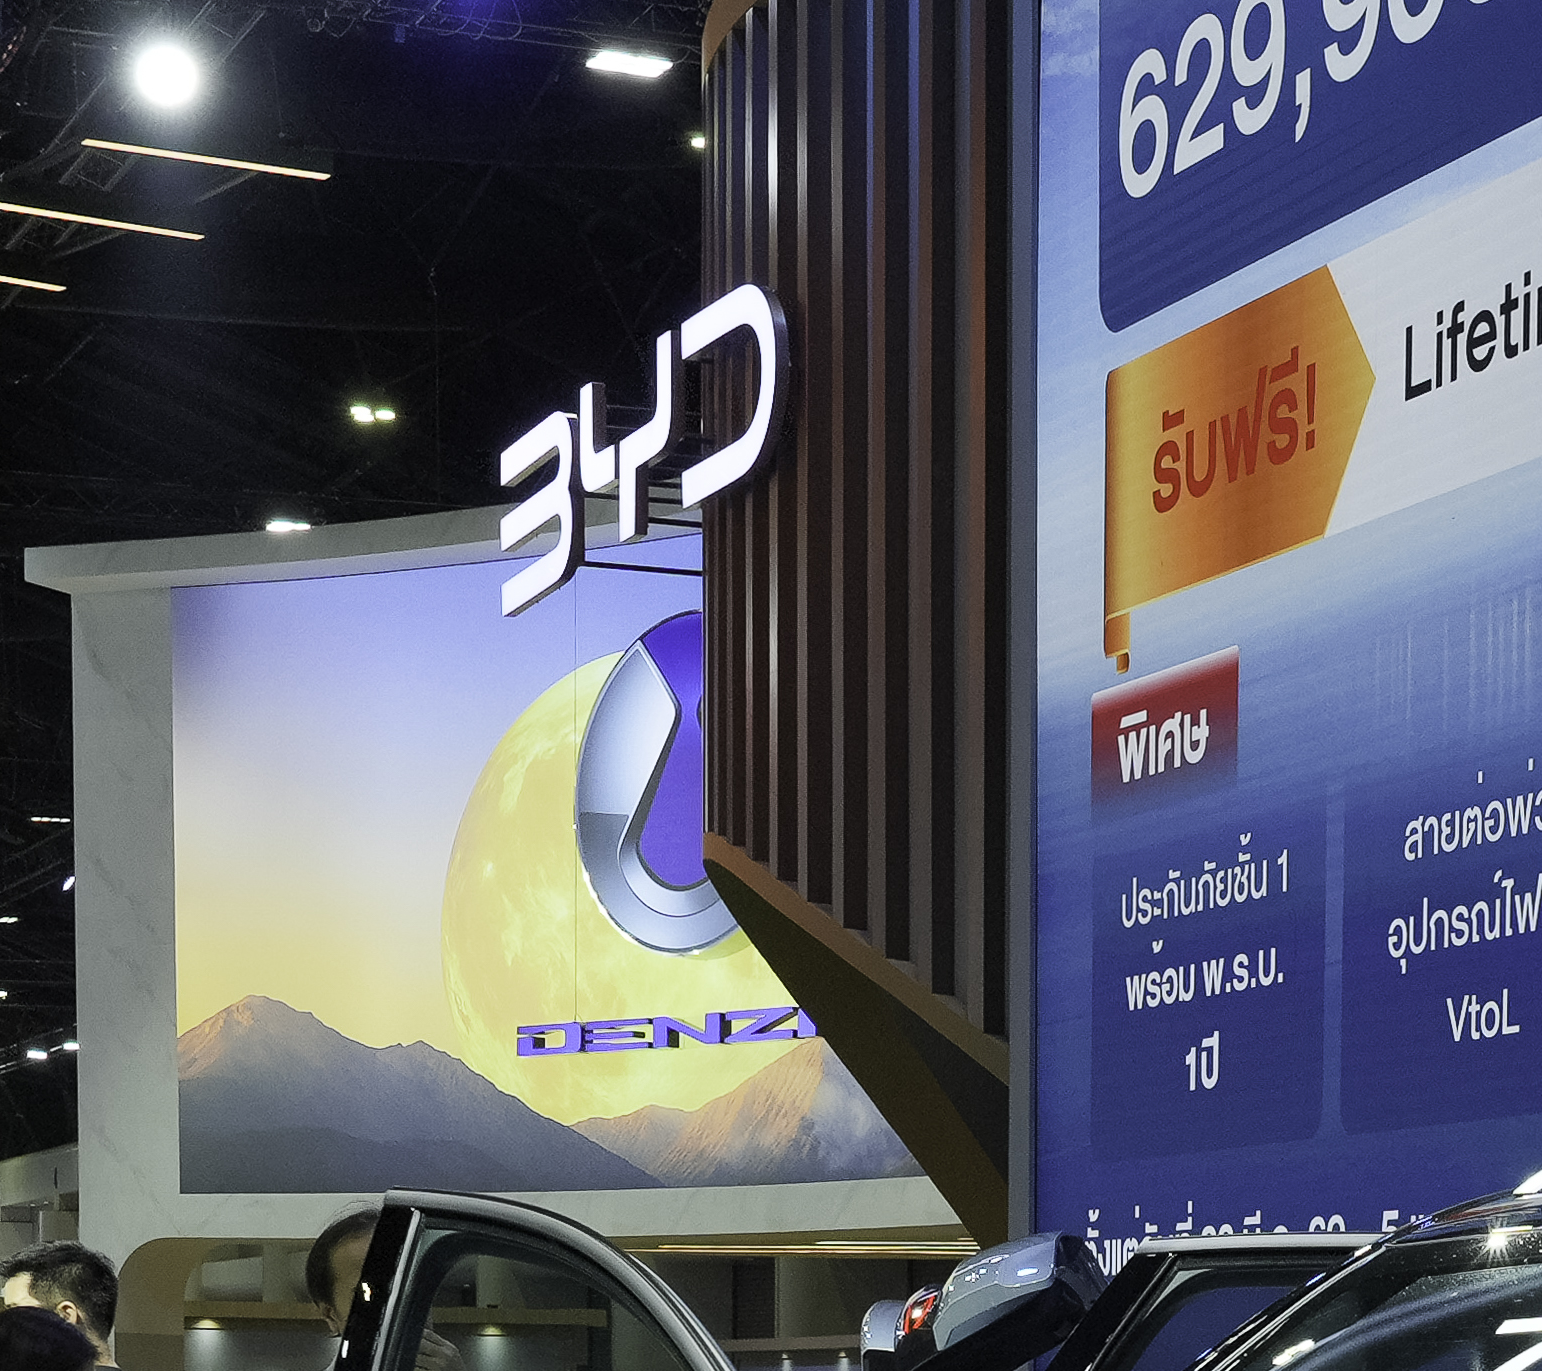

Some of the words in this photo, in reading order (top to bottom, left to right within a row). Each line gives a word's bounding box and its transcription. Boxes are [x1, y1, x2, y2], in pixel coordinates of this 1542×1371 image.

[1119, 0, 1490, 199] 629,9
[498, 283, 790, 618] BYD
[1152, 346, 1316, 517] รับฟรี!
[1118, 709, 1210, 783] พิเศษ
[1121, 833, 1268, 929] ประกันภัยชั้น
[1277, 849, 1290, 892] 1
[1126, 940, 1196, 1012] พร้อม
[1202, 948, 1284, 997] พ.ร.บ.
[1446, 989, 1520, 1043] VtoL
[1185, 1031, 1220, 1092] 1ปี
